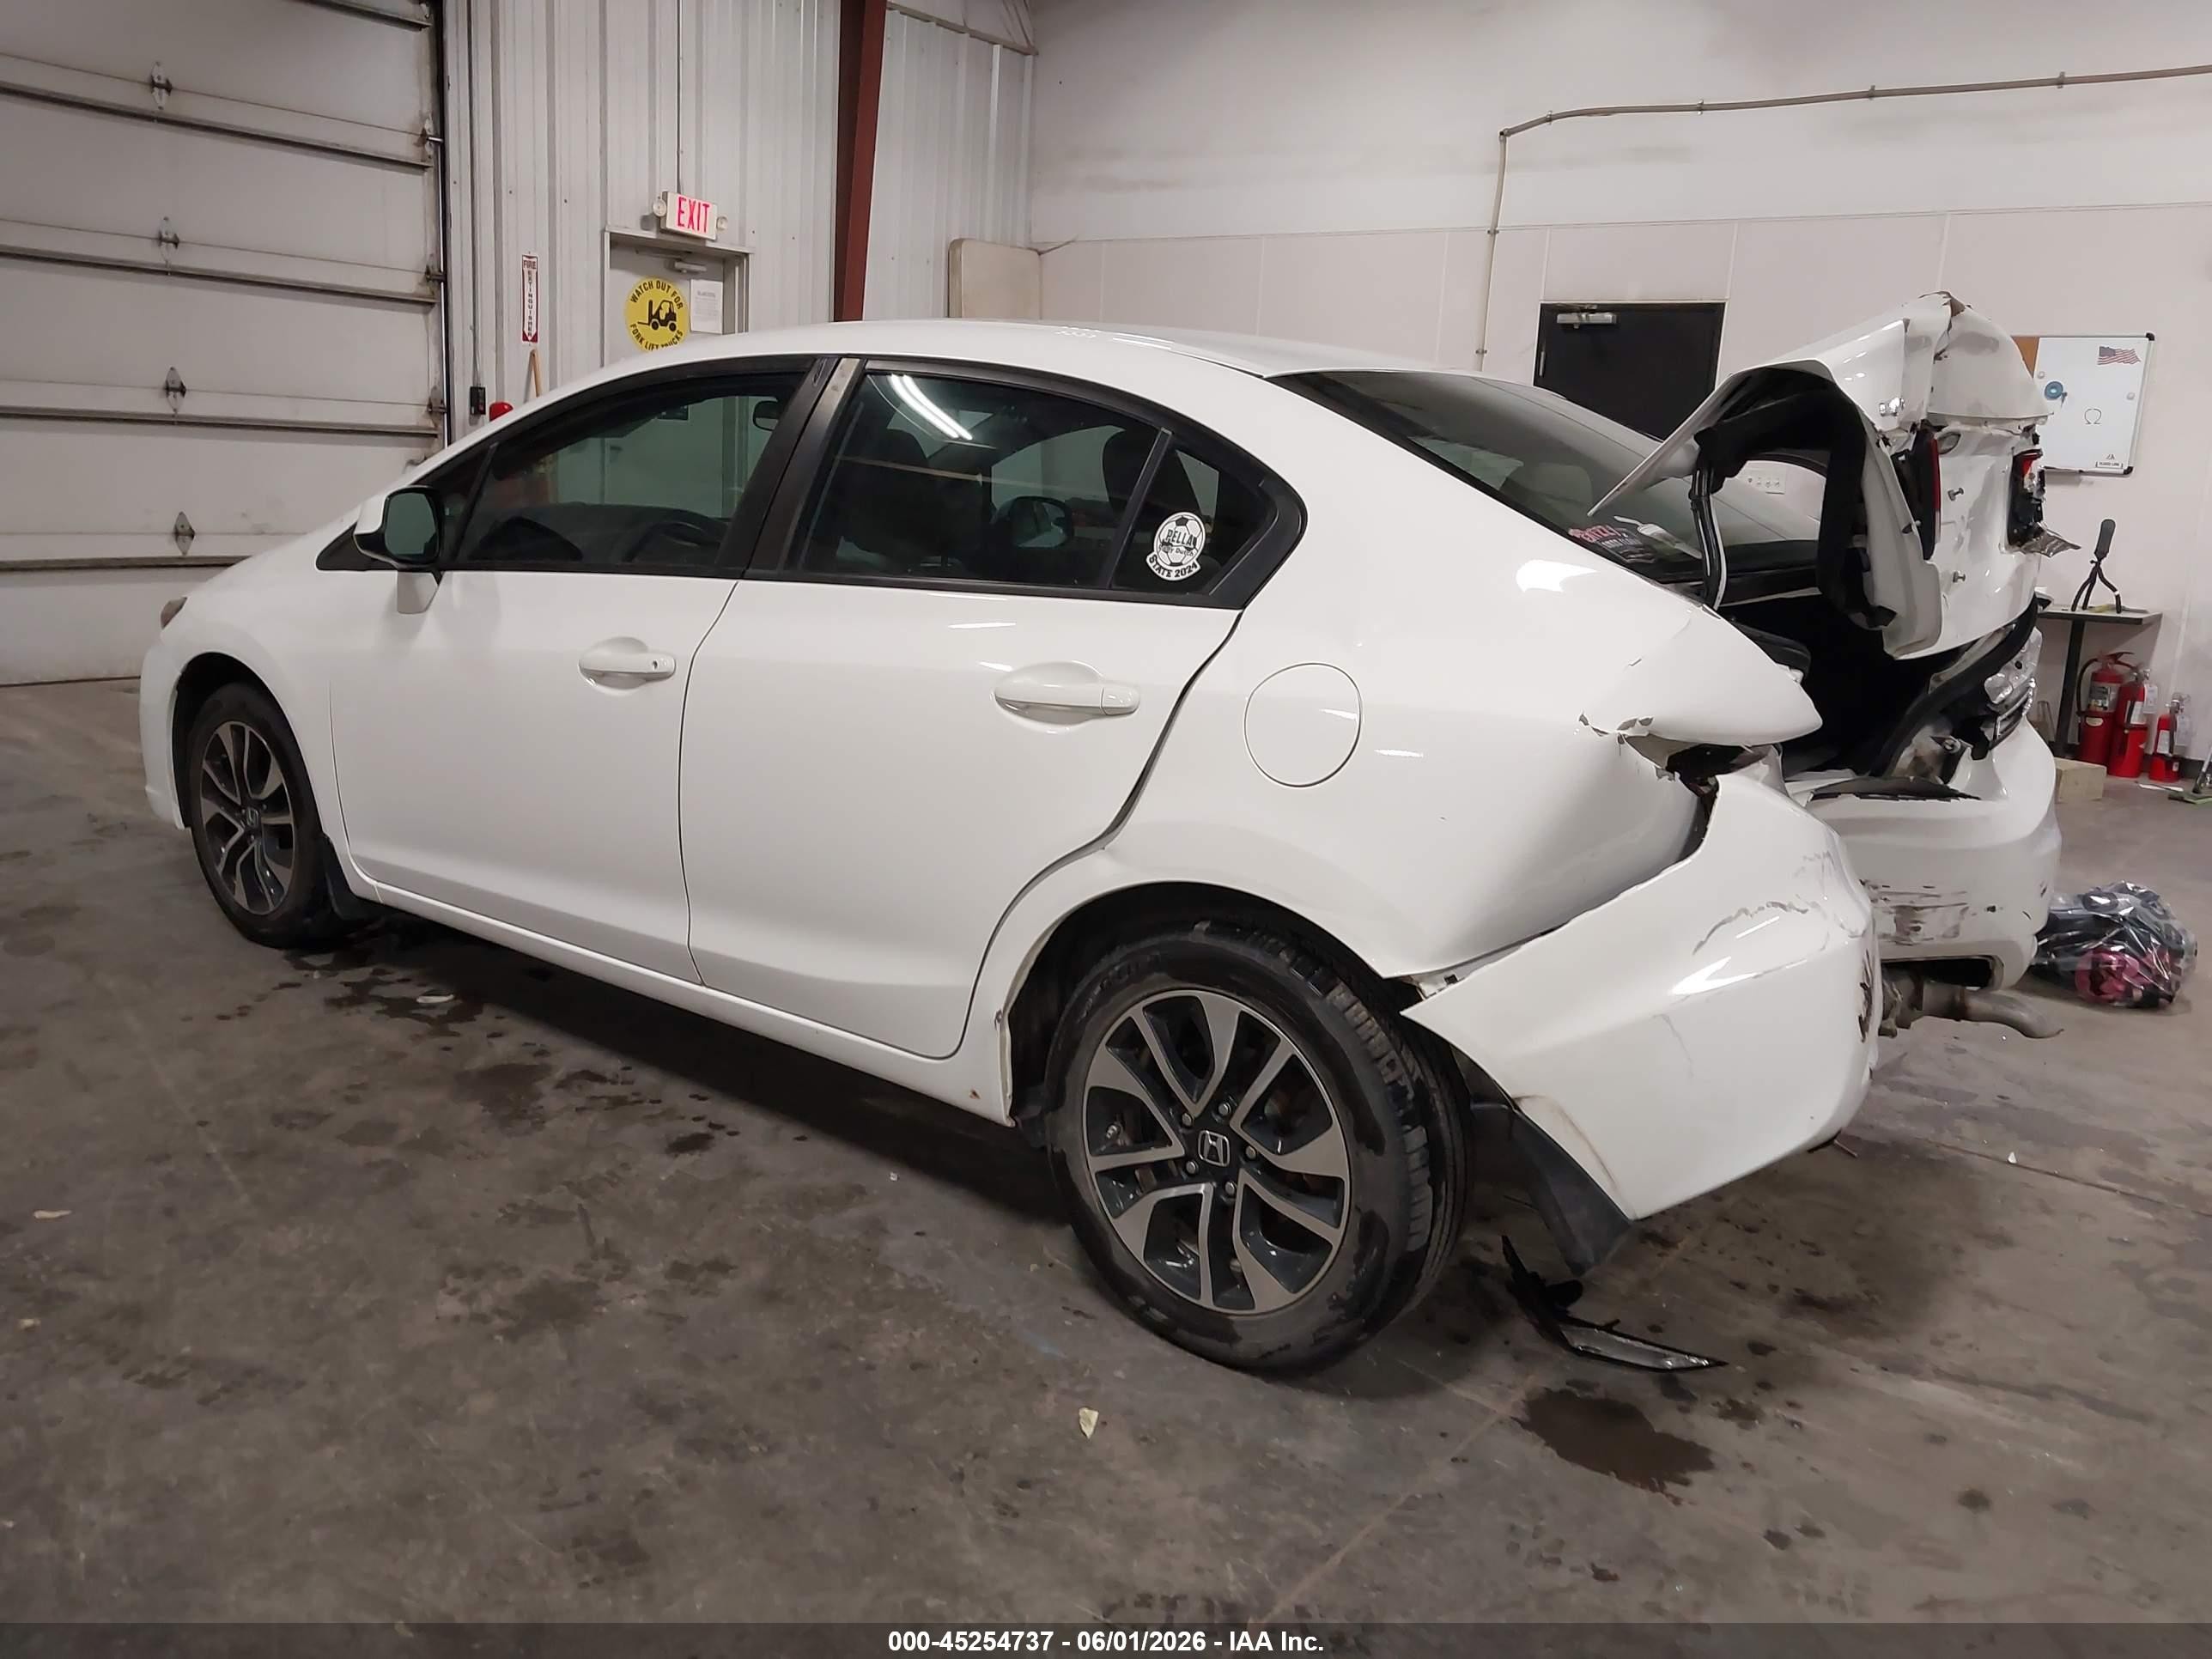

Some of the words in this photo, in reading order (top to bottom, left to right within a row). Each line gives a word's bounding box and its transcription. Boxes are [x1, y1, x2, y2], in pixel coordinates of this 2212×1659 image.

[677, 196, 709, 233] EXIT
[523, 260, 536, 269] FIRE
[630, 281, 653, 302] WATCH
[656, 280, 671, 293] OUT
[671, 290, 684, 309] FOR
[630, 324, 645, 344] FORK
[1165, 529, 1193, 546] PELLA
[1149, 554, 1172, 578] STATE
[1174, 562, 1198, 578] 2024
